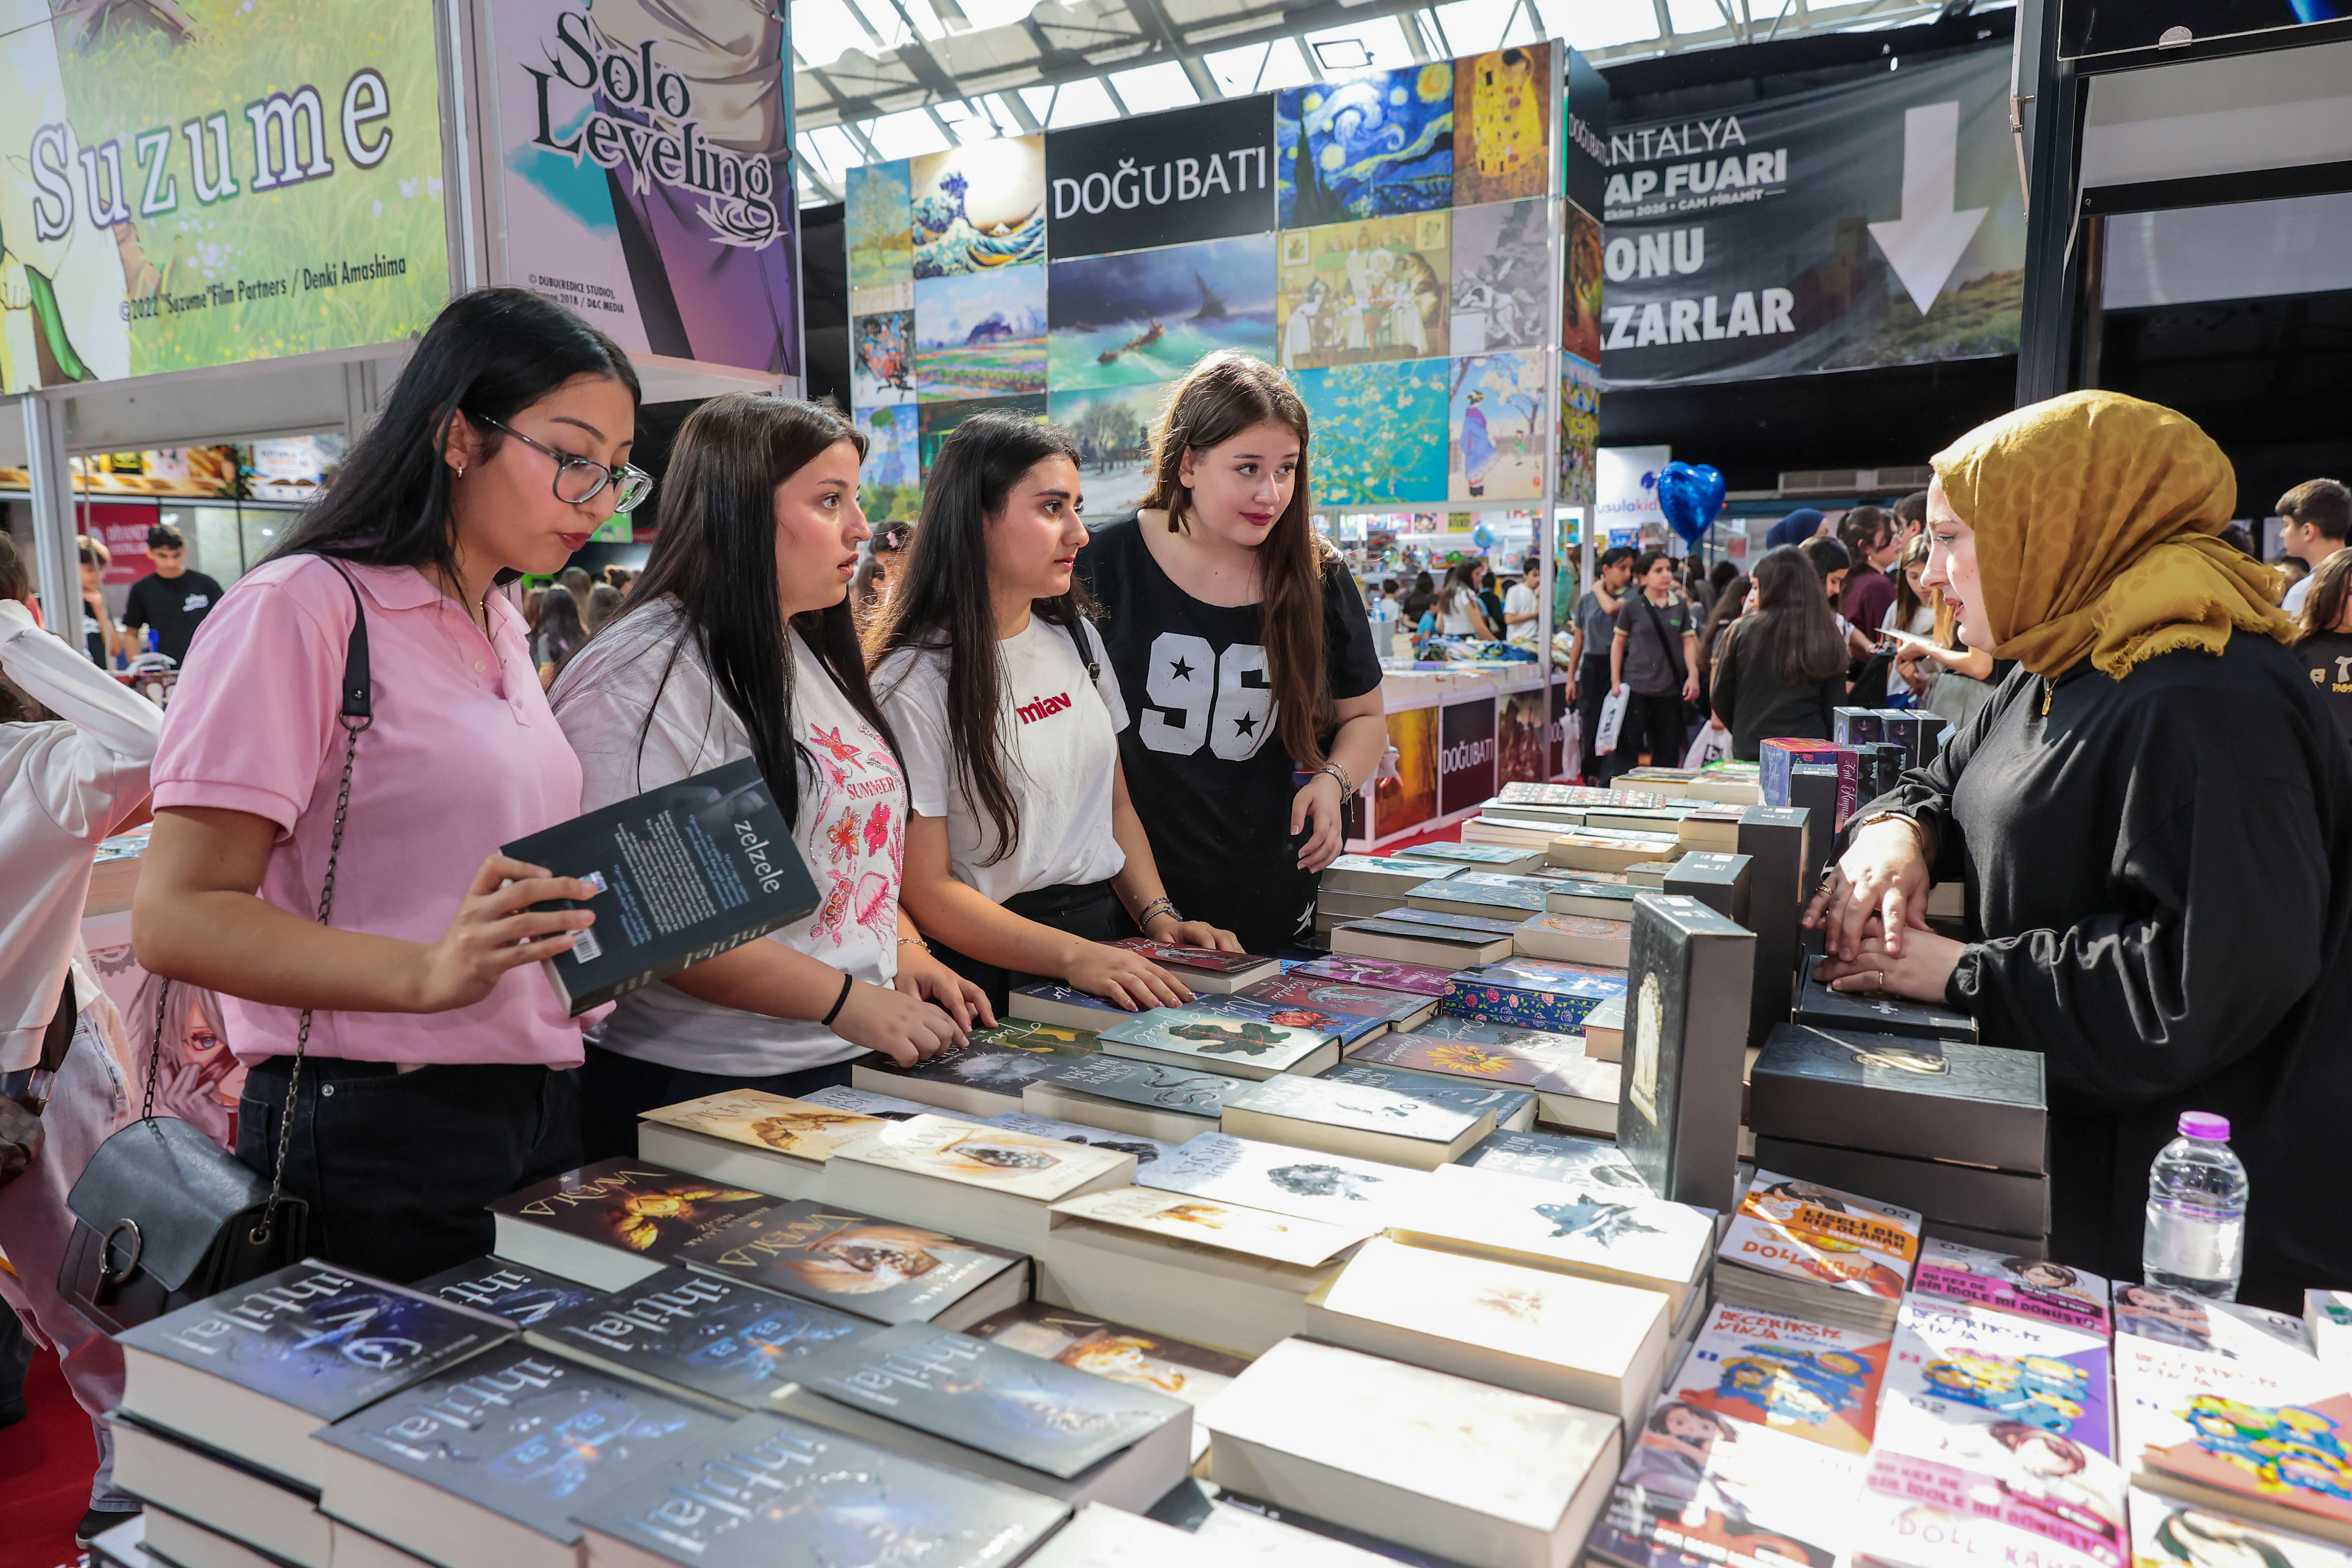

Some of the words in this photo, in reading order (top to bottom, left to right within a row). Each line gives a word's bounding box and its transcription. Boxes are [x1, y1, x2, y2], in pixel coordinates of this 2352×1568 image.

[539, 11, 691, 119] Solo
[30, 67, 393, 242] Suzume
[520, 60, 780, 241] Leveling
[1605, 116, 1747, 167] NTALYA
[1051, 146, 1266, 220] DOĞUBATI
[1604, 170, 1658, 207] AP
[1664, 148, 1788, 198] FUARI
[237, 278, 287, 301] Partners
[303, 263, 337, 291] Denki
[342, 253, 407, 285] Amashima
[603, 302, 625, 314] MEDIA
[1600, 286, 1796, 351] ZARLAR
[1015, 692, 1072, 725] miav
[1139, 631, 1279, 762] 96
[1442, 737, 1494, 775] DOĞUBATI
[846, 776, 894, 800] SUMMER
[734, 819, 784, 894] zelzele
[980, 1021, 1041, 1044] Tüne
[1210, 995, 1272, 1017] Nehi
[1054, 1064, 1089, 1082] SEN
[1090, 1058, 1120, 1072] BİR
[1363, 1069, 1396, 1087] İÇİN
[835, 1098, 872, 1110] İÇİ
[1031, 1124, 1056, 1138] İÇİ
[158, 1270, 355, 1357] ihtilal
[560, 1276, 730, 1352] ihtilal
[823, 1334, 986, 1408] ihtilal
[357, 1355, 566, 1464] ihtilal
[620, 1430, 828, 1556] ihtilal
